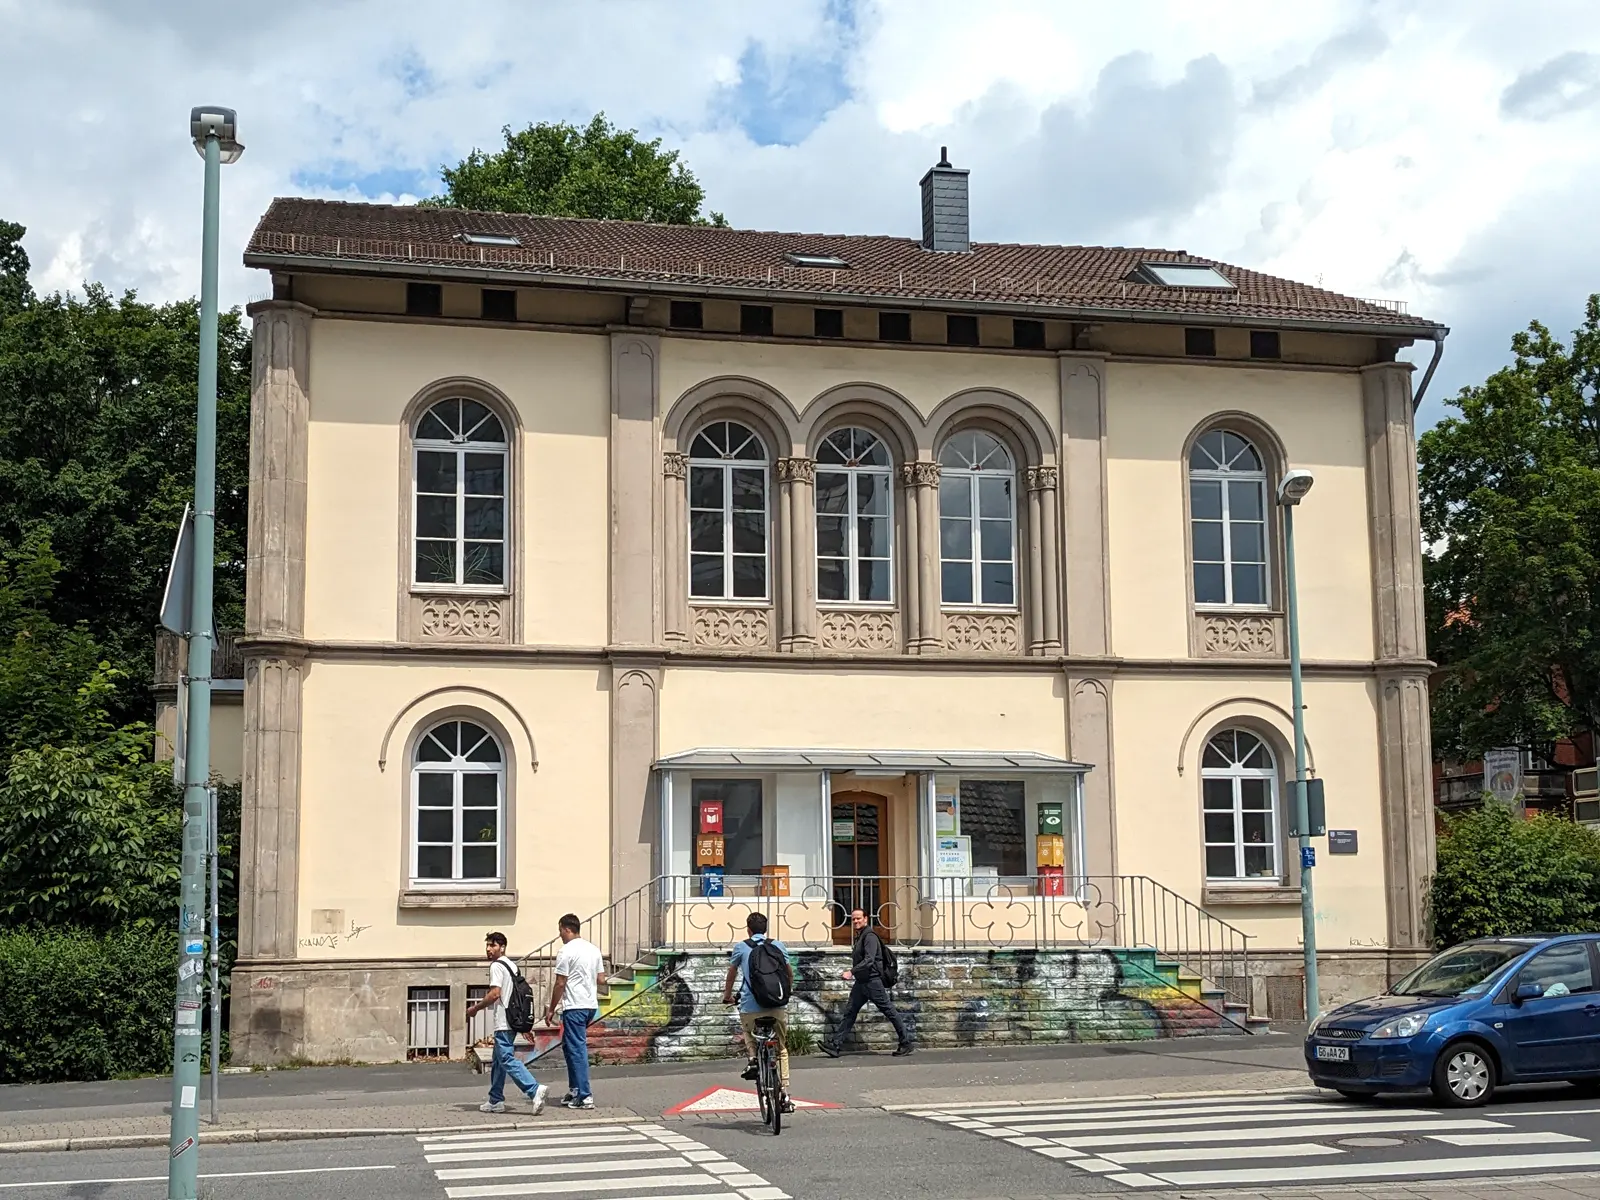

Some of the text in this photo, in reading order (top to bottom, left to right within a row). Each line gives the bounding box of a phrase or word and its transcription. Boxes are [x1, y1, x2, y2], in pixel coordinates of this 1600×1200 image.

[1318, 1046, 1346, 1058] GÖ AA 29
